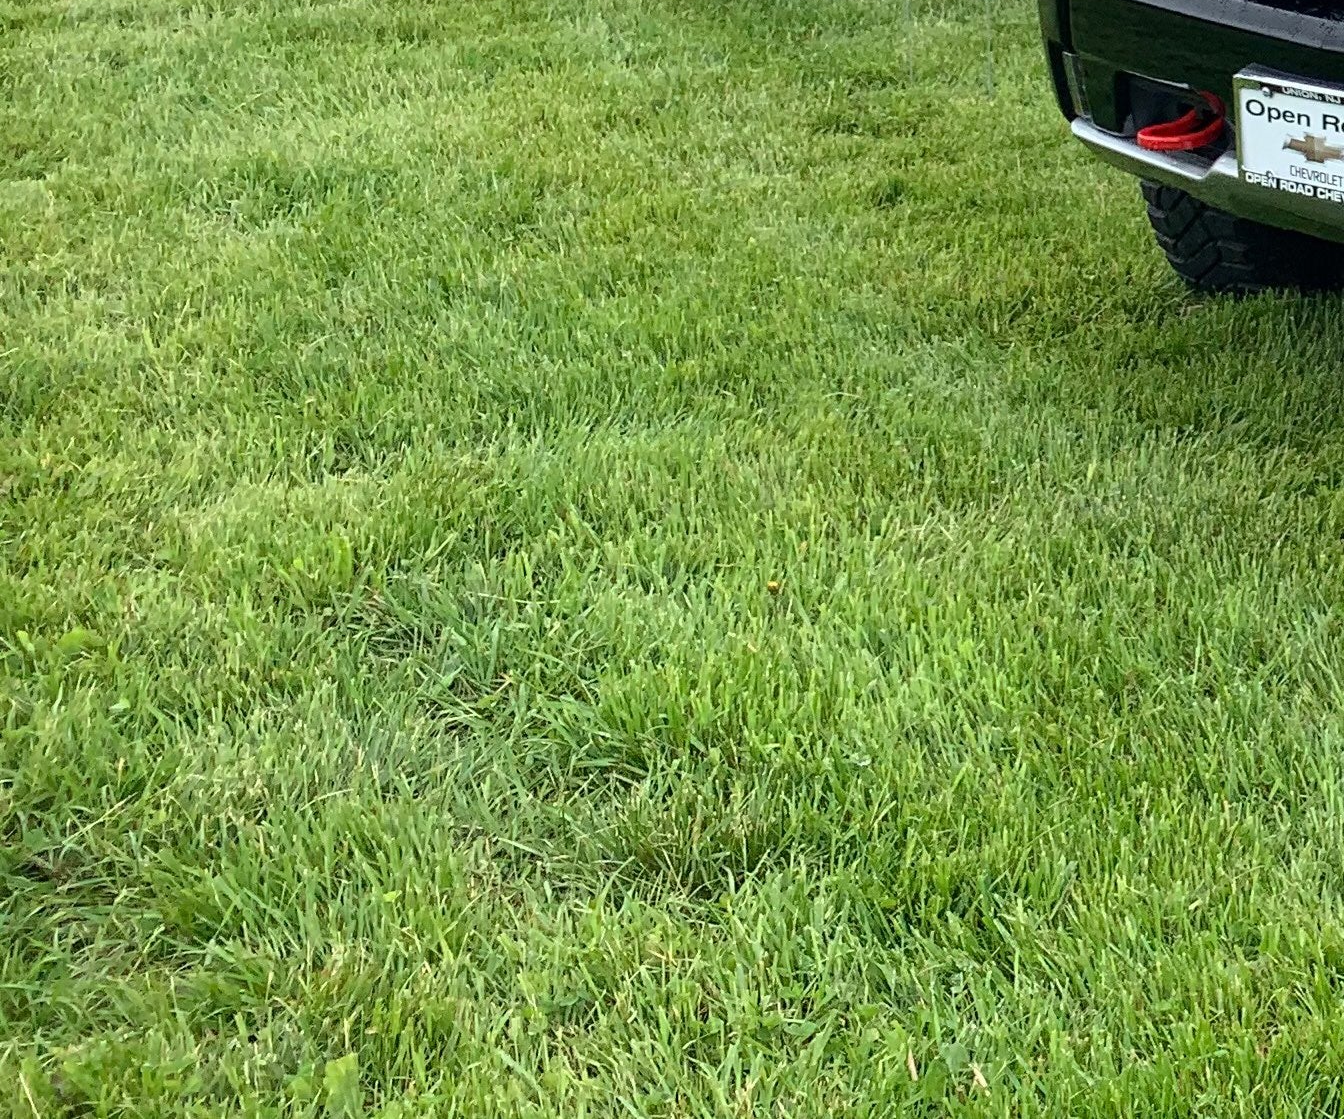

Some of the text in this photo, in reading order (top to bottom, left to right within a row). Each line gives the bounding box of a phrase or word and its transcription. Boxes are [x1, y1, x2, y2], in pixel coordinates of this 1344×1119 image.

[1245, 99, 1311, 128] Open
[1245, 171, 1278, 190] OPEN
[1279, 181, 1314, 198] ROAD
[1289, 164, 1344, 188] CHEVROLET
